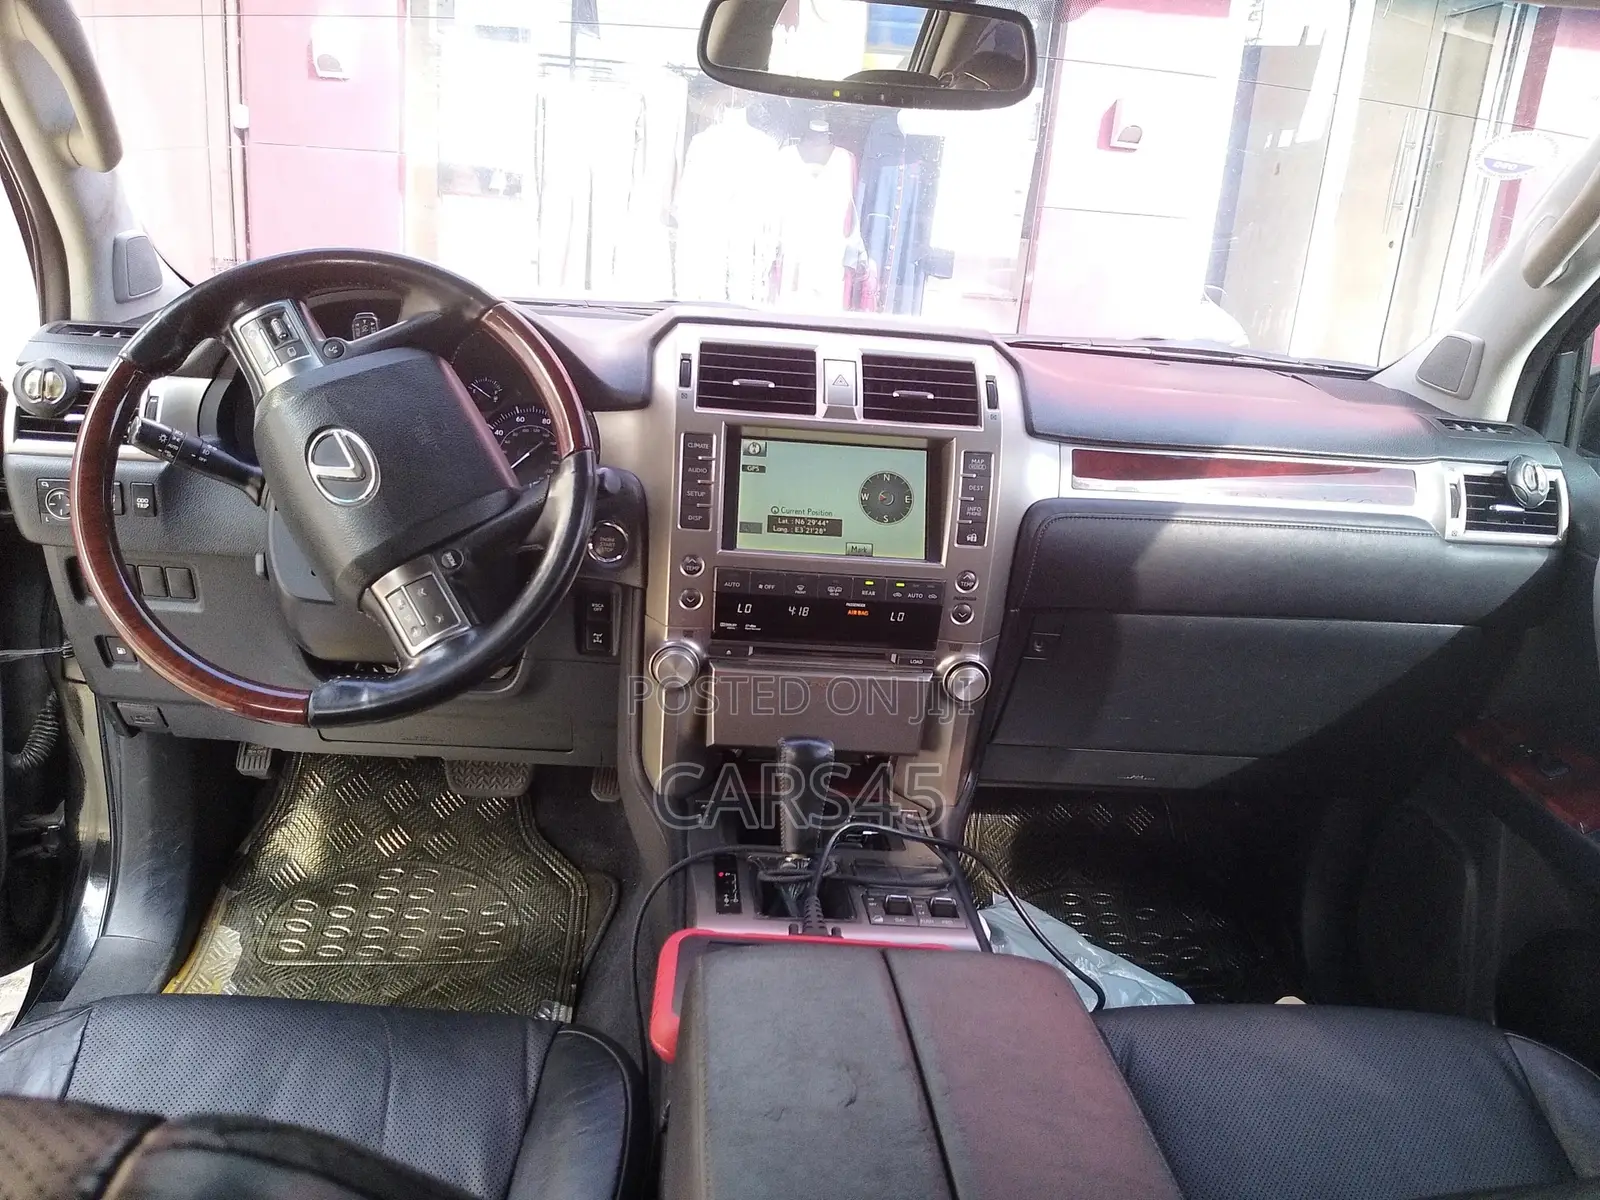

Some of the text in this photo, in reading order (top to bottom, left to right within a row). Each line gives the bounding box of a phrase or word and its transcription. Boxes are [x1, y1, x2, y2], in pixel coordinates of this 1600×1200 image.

[861, 492, 869, 500] W
[781, 506, 833, 517] Current Position
[883, 514, 889, 522] S
[851, 546, 868, 554] Mark
